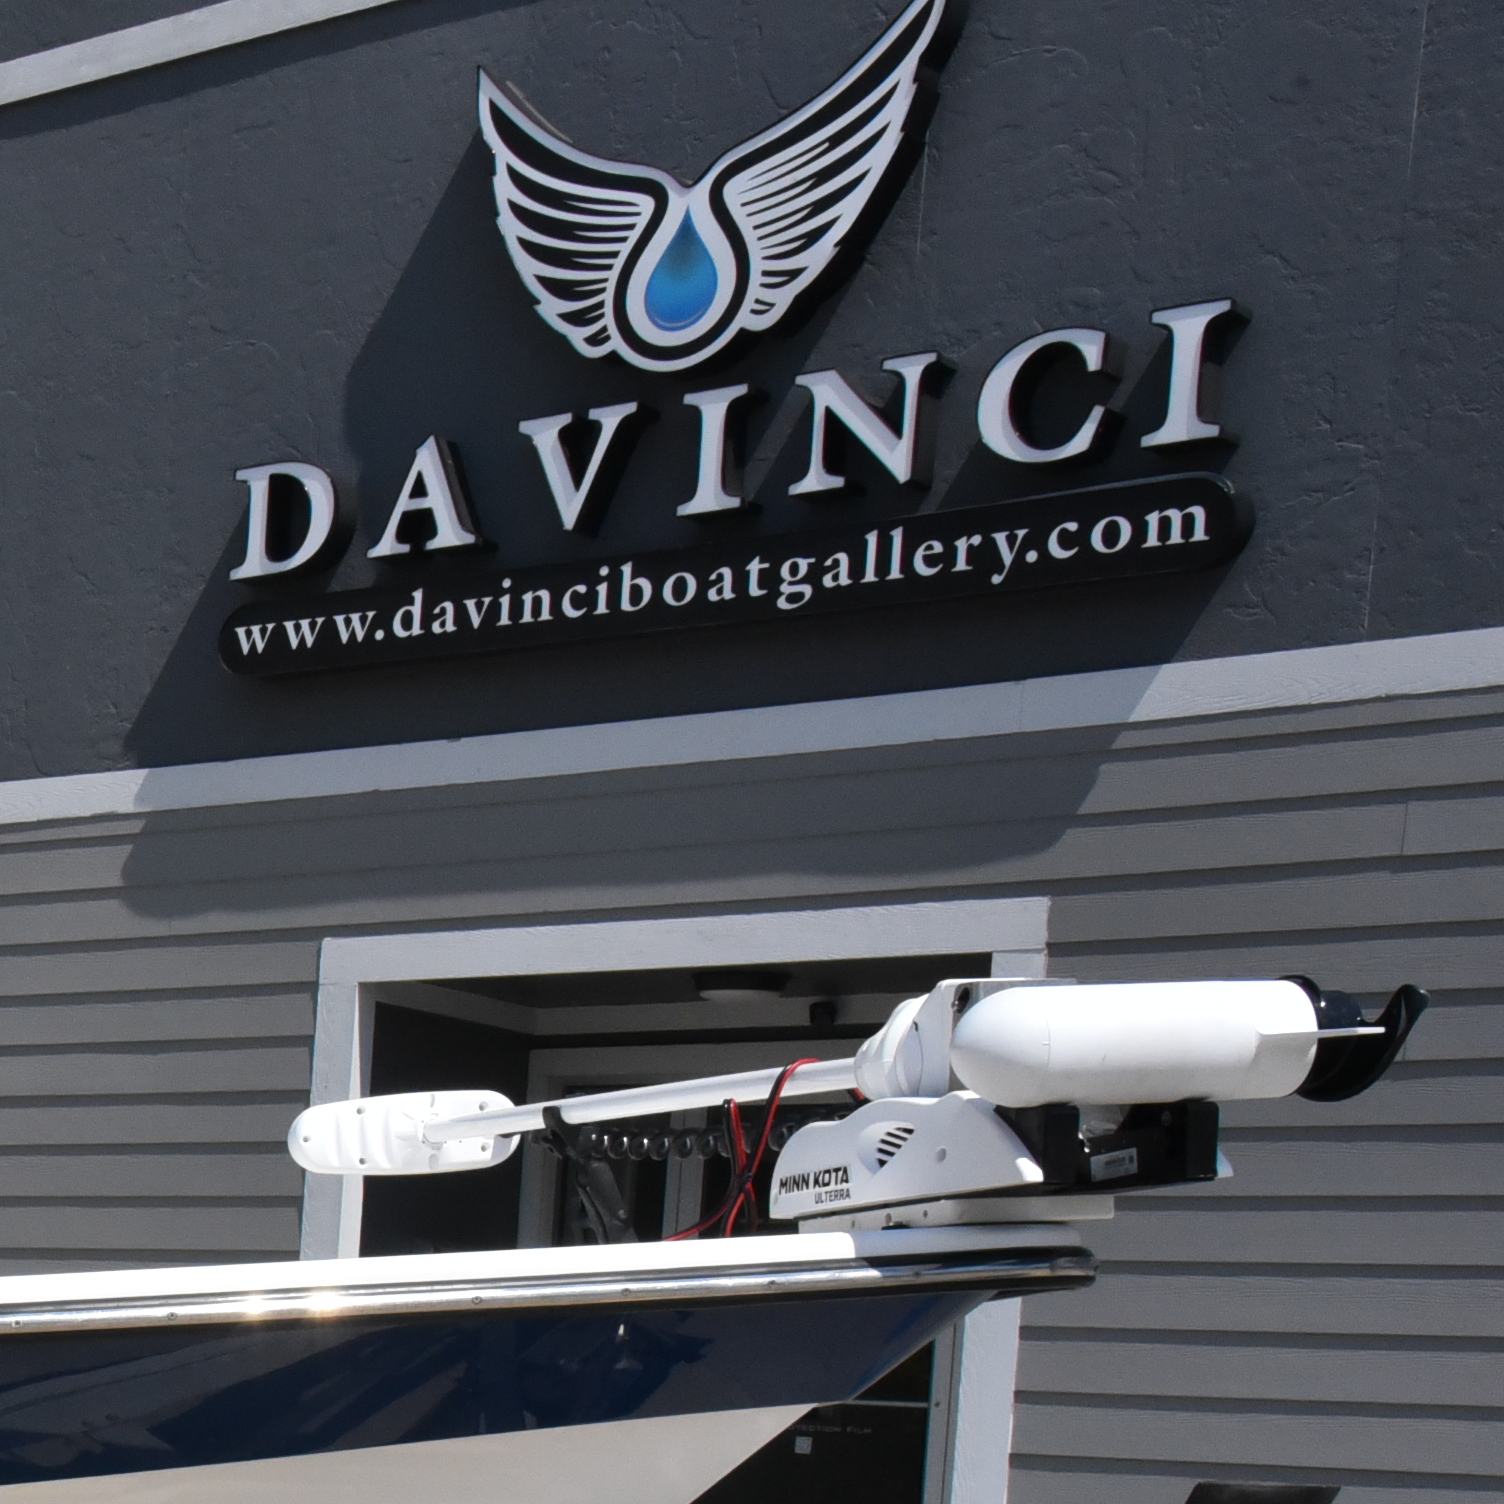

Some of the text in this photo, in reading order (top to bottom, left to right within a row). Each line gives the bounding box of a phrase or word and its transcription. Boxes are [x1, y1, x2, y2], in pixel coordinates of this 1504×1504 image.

[229, 299, 1232, 581] DAVINCI
[233, 503, 1211, 657] www.davinciboatgallery.com
[778, 1166, 850, 1195] MINN KOTA
[814, 1188, 851, 1205] ULTERRA
